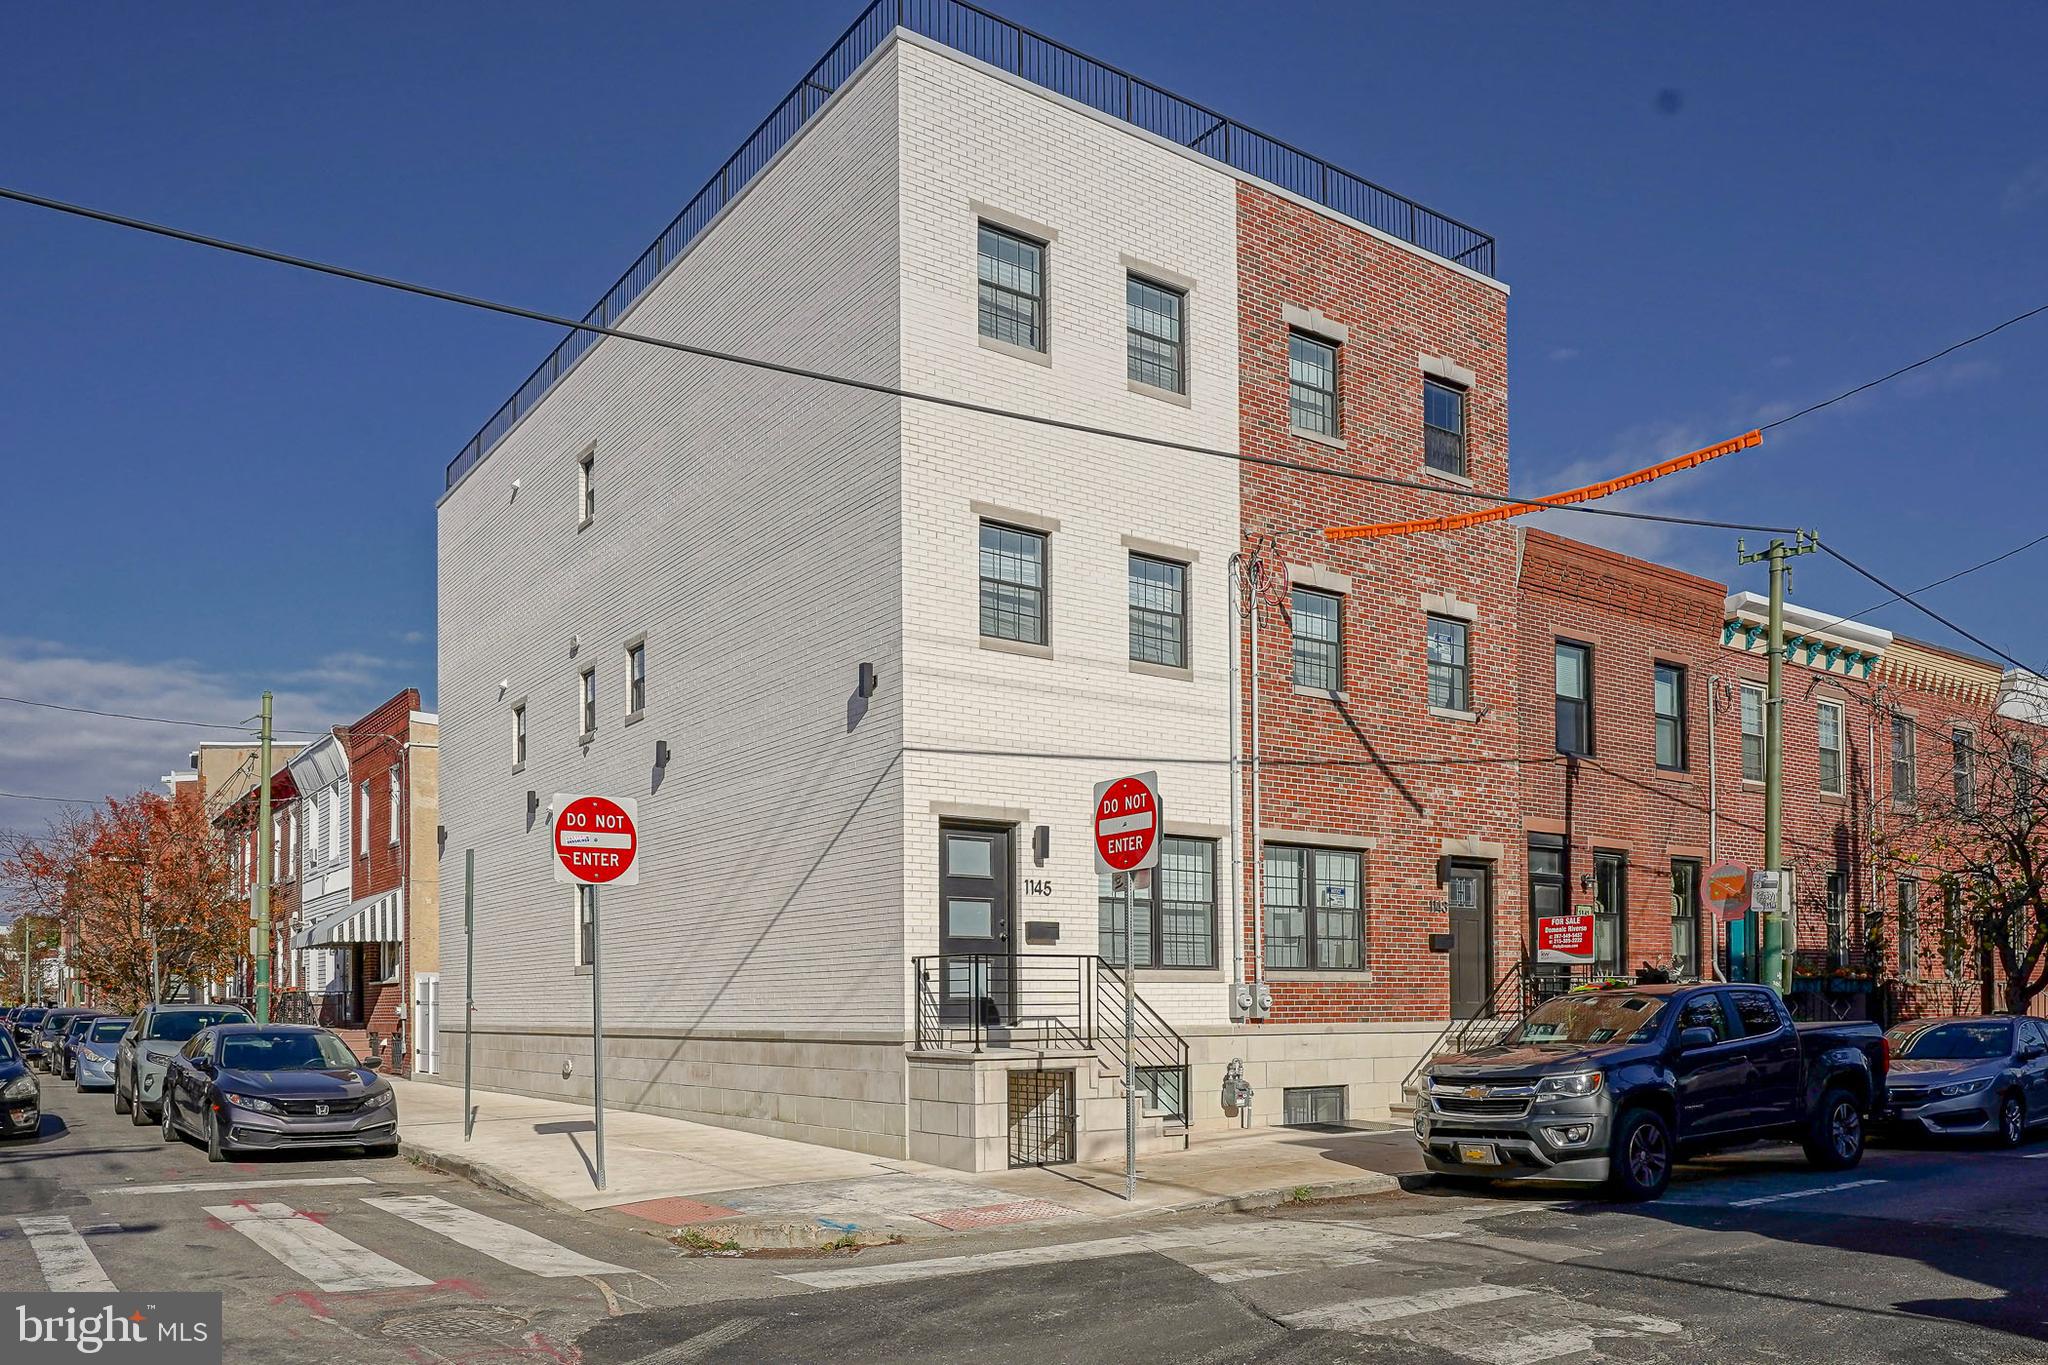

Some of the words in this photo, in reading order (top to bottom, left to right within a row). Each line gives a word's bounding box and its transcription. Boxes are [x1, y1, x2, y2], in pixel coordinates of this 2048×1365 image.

[1103, 798, 1119, 815] DO
[1125, 793, 1147, 811] NOT
[566, 812, 587, 827] DO
[595, 814, 624, 829] NOT
[1108, 836, 1143, 854] ENTER
[573, 851, 619, 867] ENTER
[1024, 879, 1052, 896] 1145
[1551, 918, 1564, 926] FOR
[1565, 917, 1581, 925] SALE
